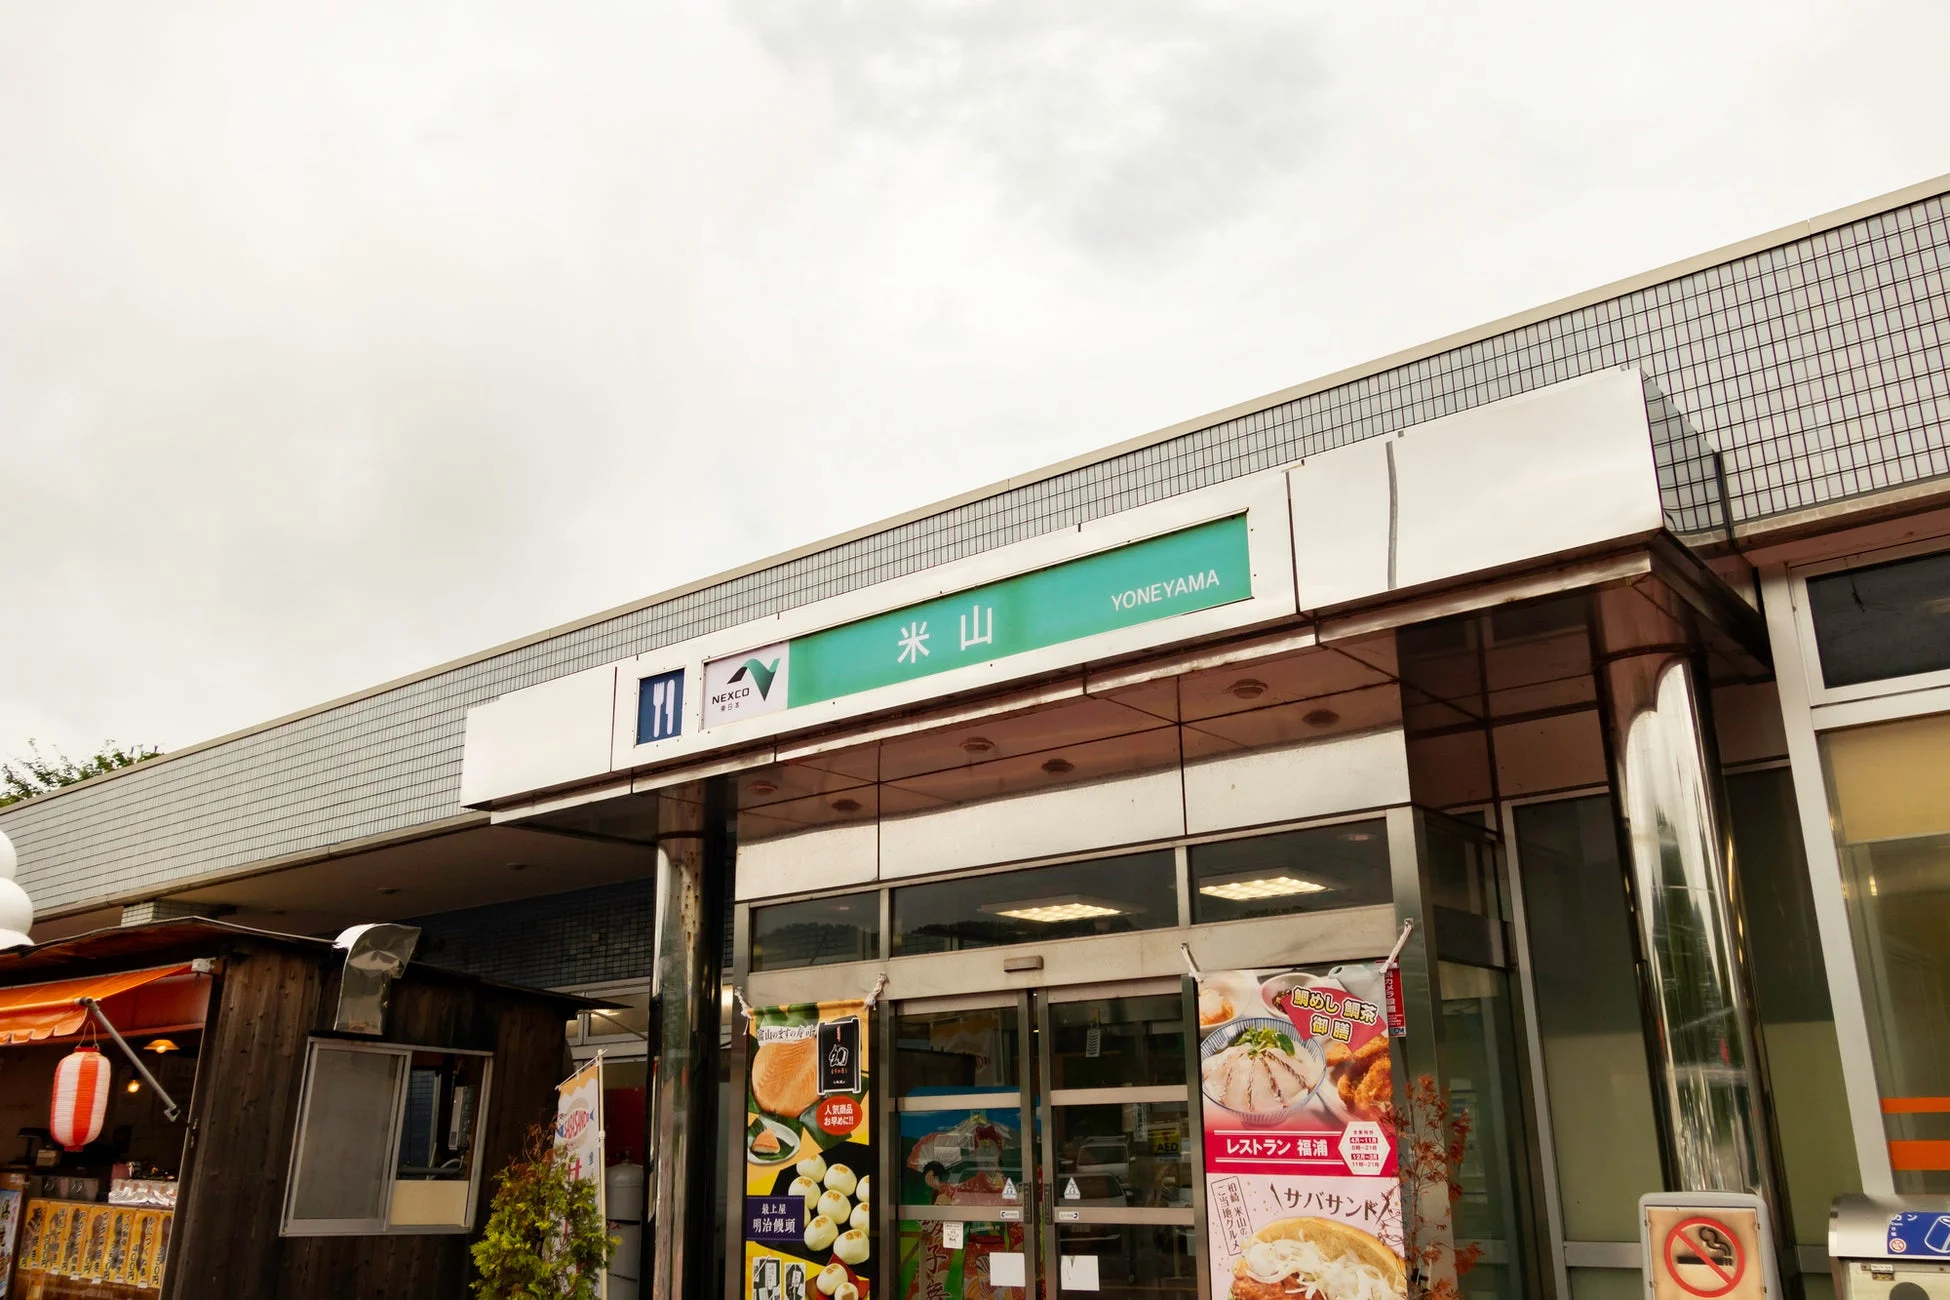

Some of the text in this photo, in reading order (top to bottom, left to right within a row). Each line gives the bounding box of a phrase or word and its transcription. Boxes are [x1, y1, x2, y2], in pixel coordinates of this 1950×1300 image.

[1111, 568, 1220, 611] YONEYAMA
[712, 687, 750, 705] NEXCO
[1293, 987, 1339, 1014] 鯛めし
[1342, 998, 1378, 1024] 鯛茶
[824, 1104, 853, 1115] 人気商品
[1157, 1142, 1179, 1152] AED
[1226, 1138, 1329, 1157] レストラン 福浦
[761, 1204, 787, 1215] 最上屋
[1284, 1187, 1378, 1221] サバサンド
[752, 1218, 796, 1233] 明治饅頭
